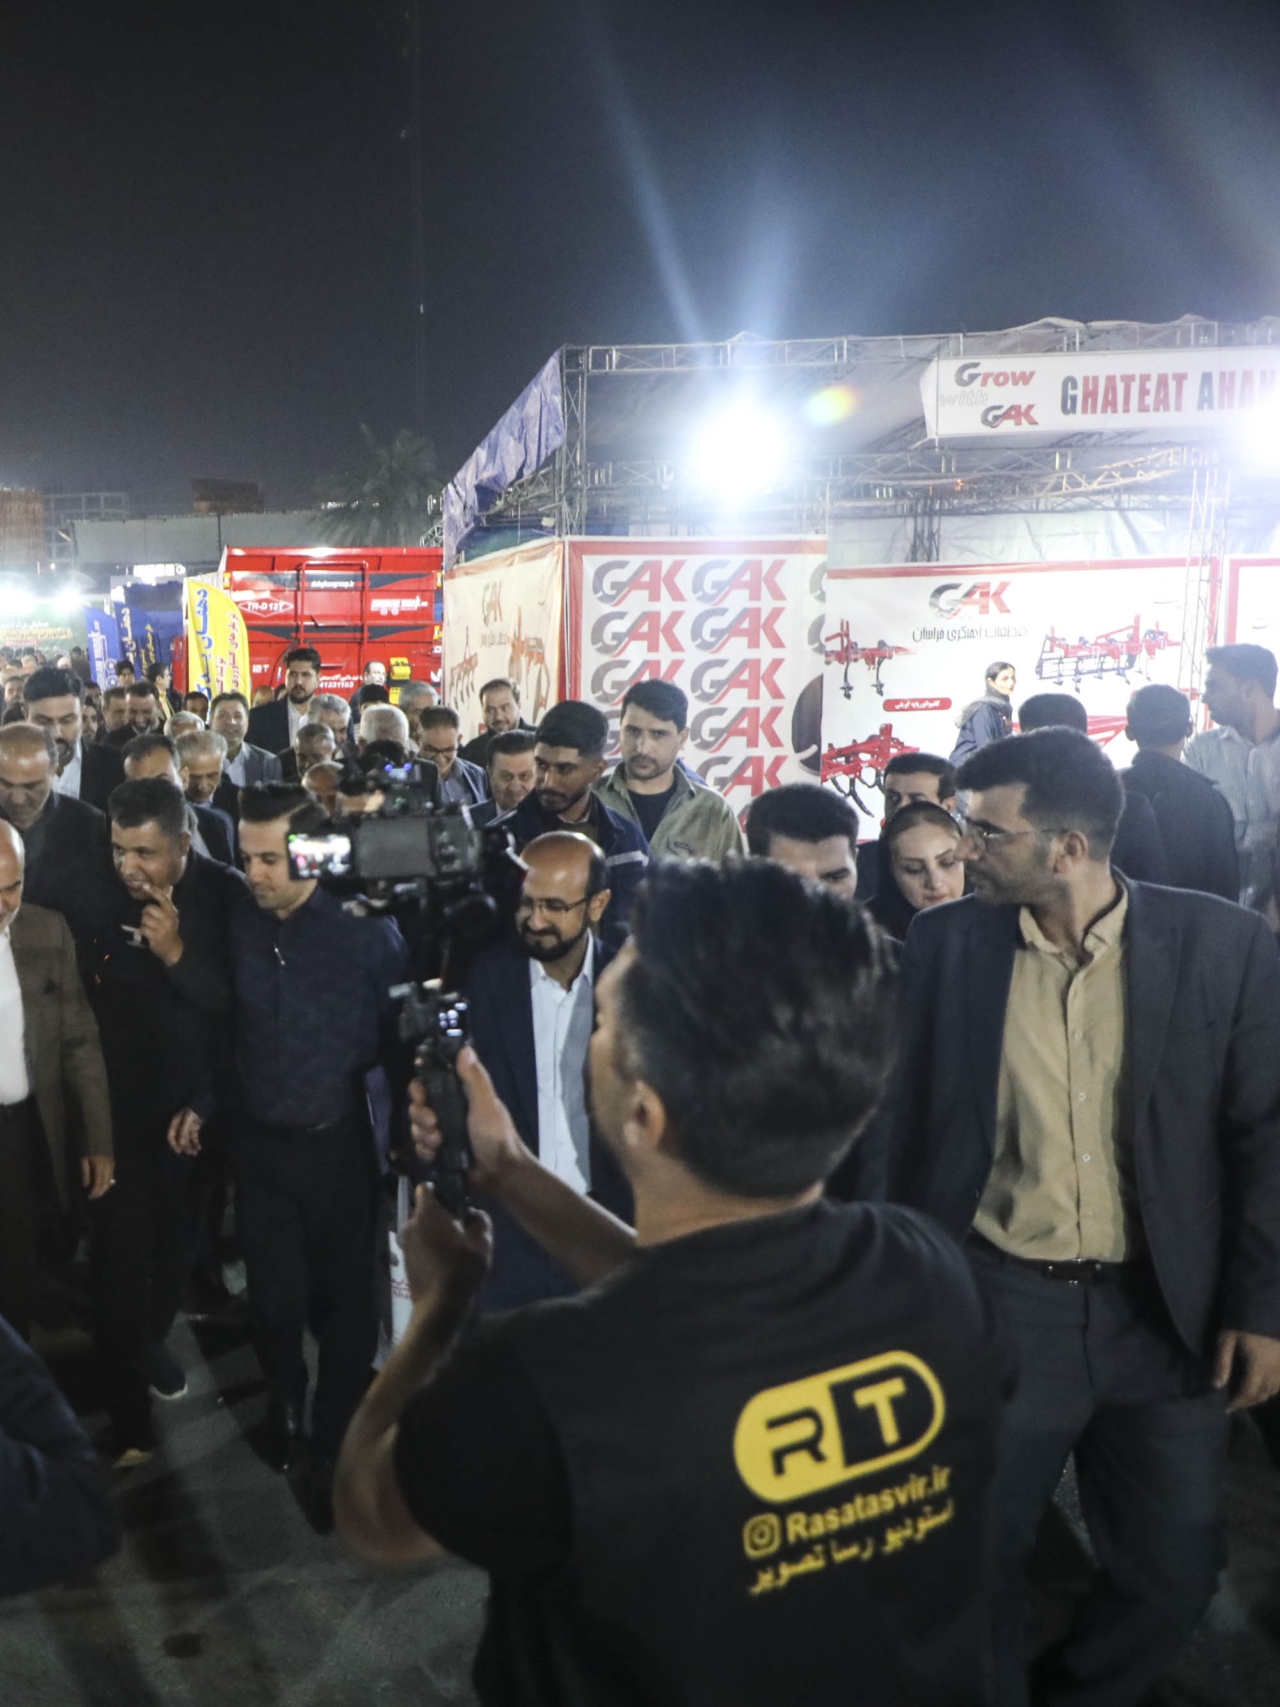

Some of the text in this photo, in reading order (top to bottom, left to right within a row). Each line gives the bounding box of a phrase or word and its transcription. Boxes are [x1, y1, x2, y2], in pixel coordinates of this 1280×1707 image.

[939, 389, 988, 408] with
[980, 404, 1039, 429] GAK
[1061, 372, 1188, 416] GHATEAT
[592, 559, 687, 607] GAK
[691, 559, 788, 606] GAK
[928, 580, 1012, 620] GAK
[591, 610, 685, 657] GAK
[690, 607, 786, 654] GAK
[690, 658, 786, 705] GAK
[689, 706, 785, 753] GAK
[786, 1464, 952, 1544] Rasatasvir.ir
